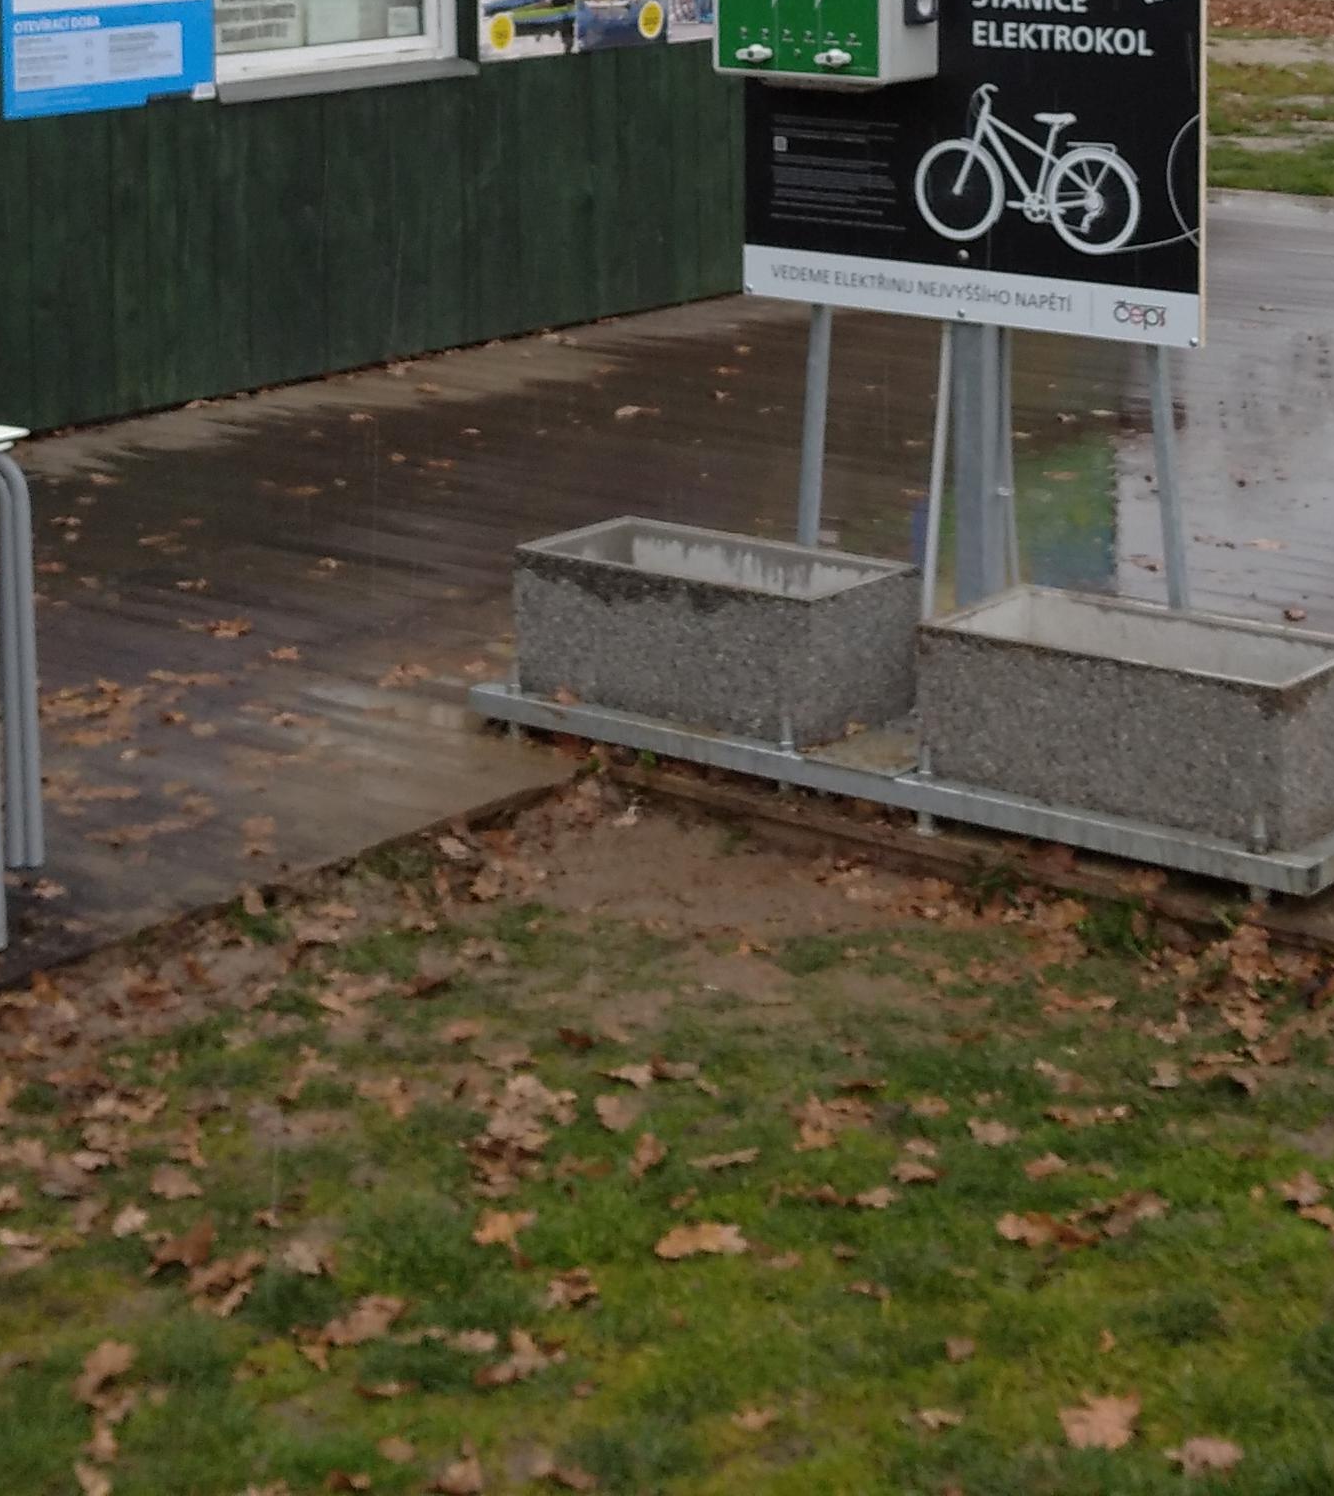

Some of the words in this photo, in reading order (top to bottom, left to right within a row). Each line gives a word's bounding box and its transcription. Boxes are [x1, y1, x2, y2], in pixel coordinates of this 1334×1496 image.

[972, 19, 1154, 57] ELEKTROKOL
[770, 264, 831, 285] VEDEME
[833, 271, 914, 295] ELEKTŘINU
[917, 279, 1011, 306] NEJVYŠŠÍHO
